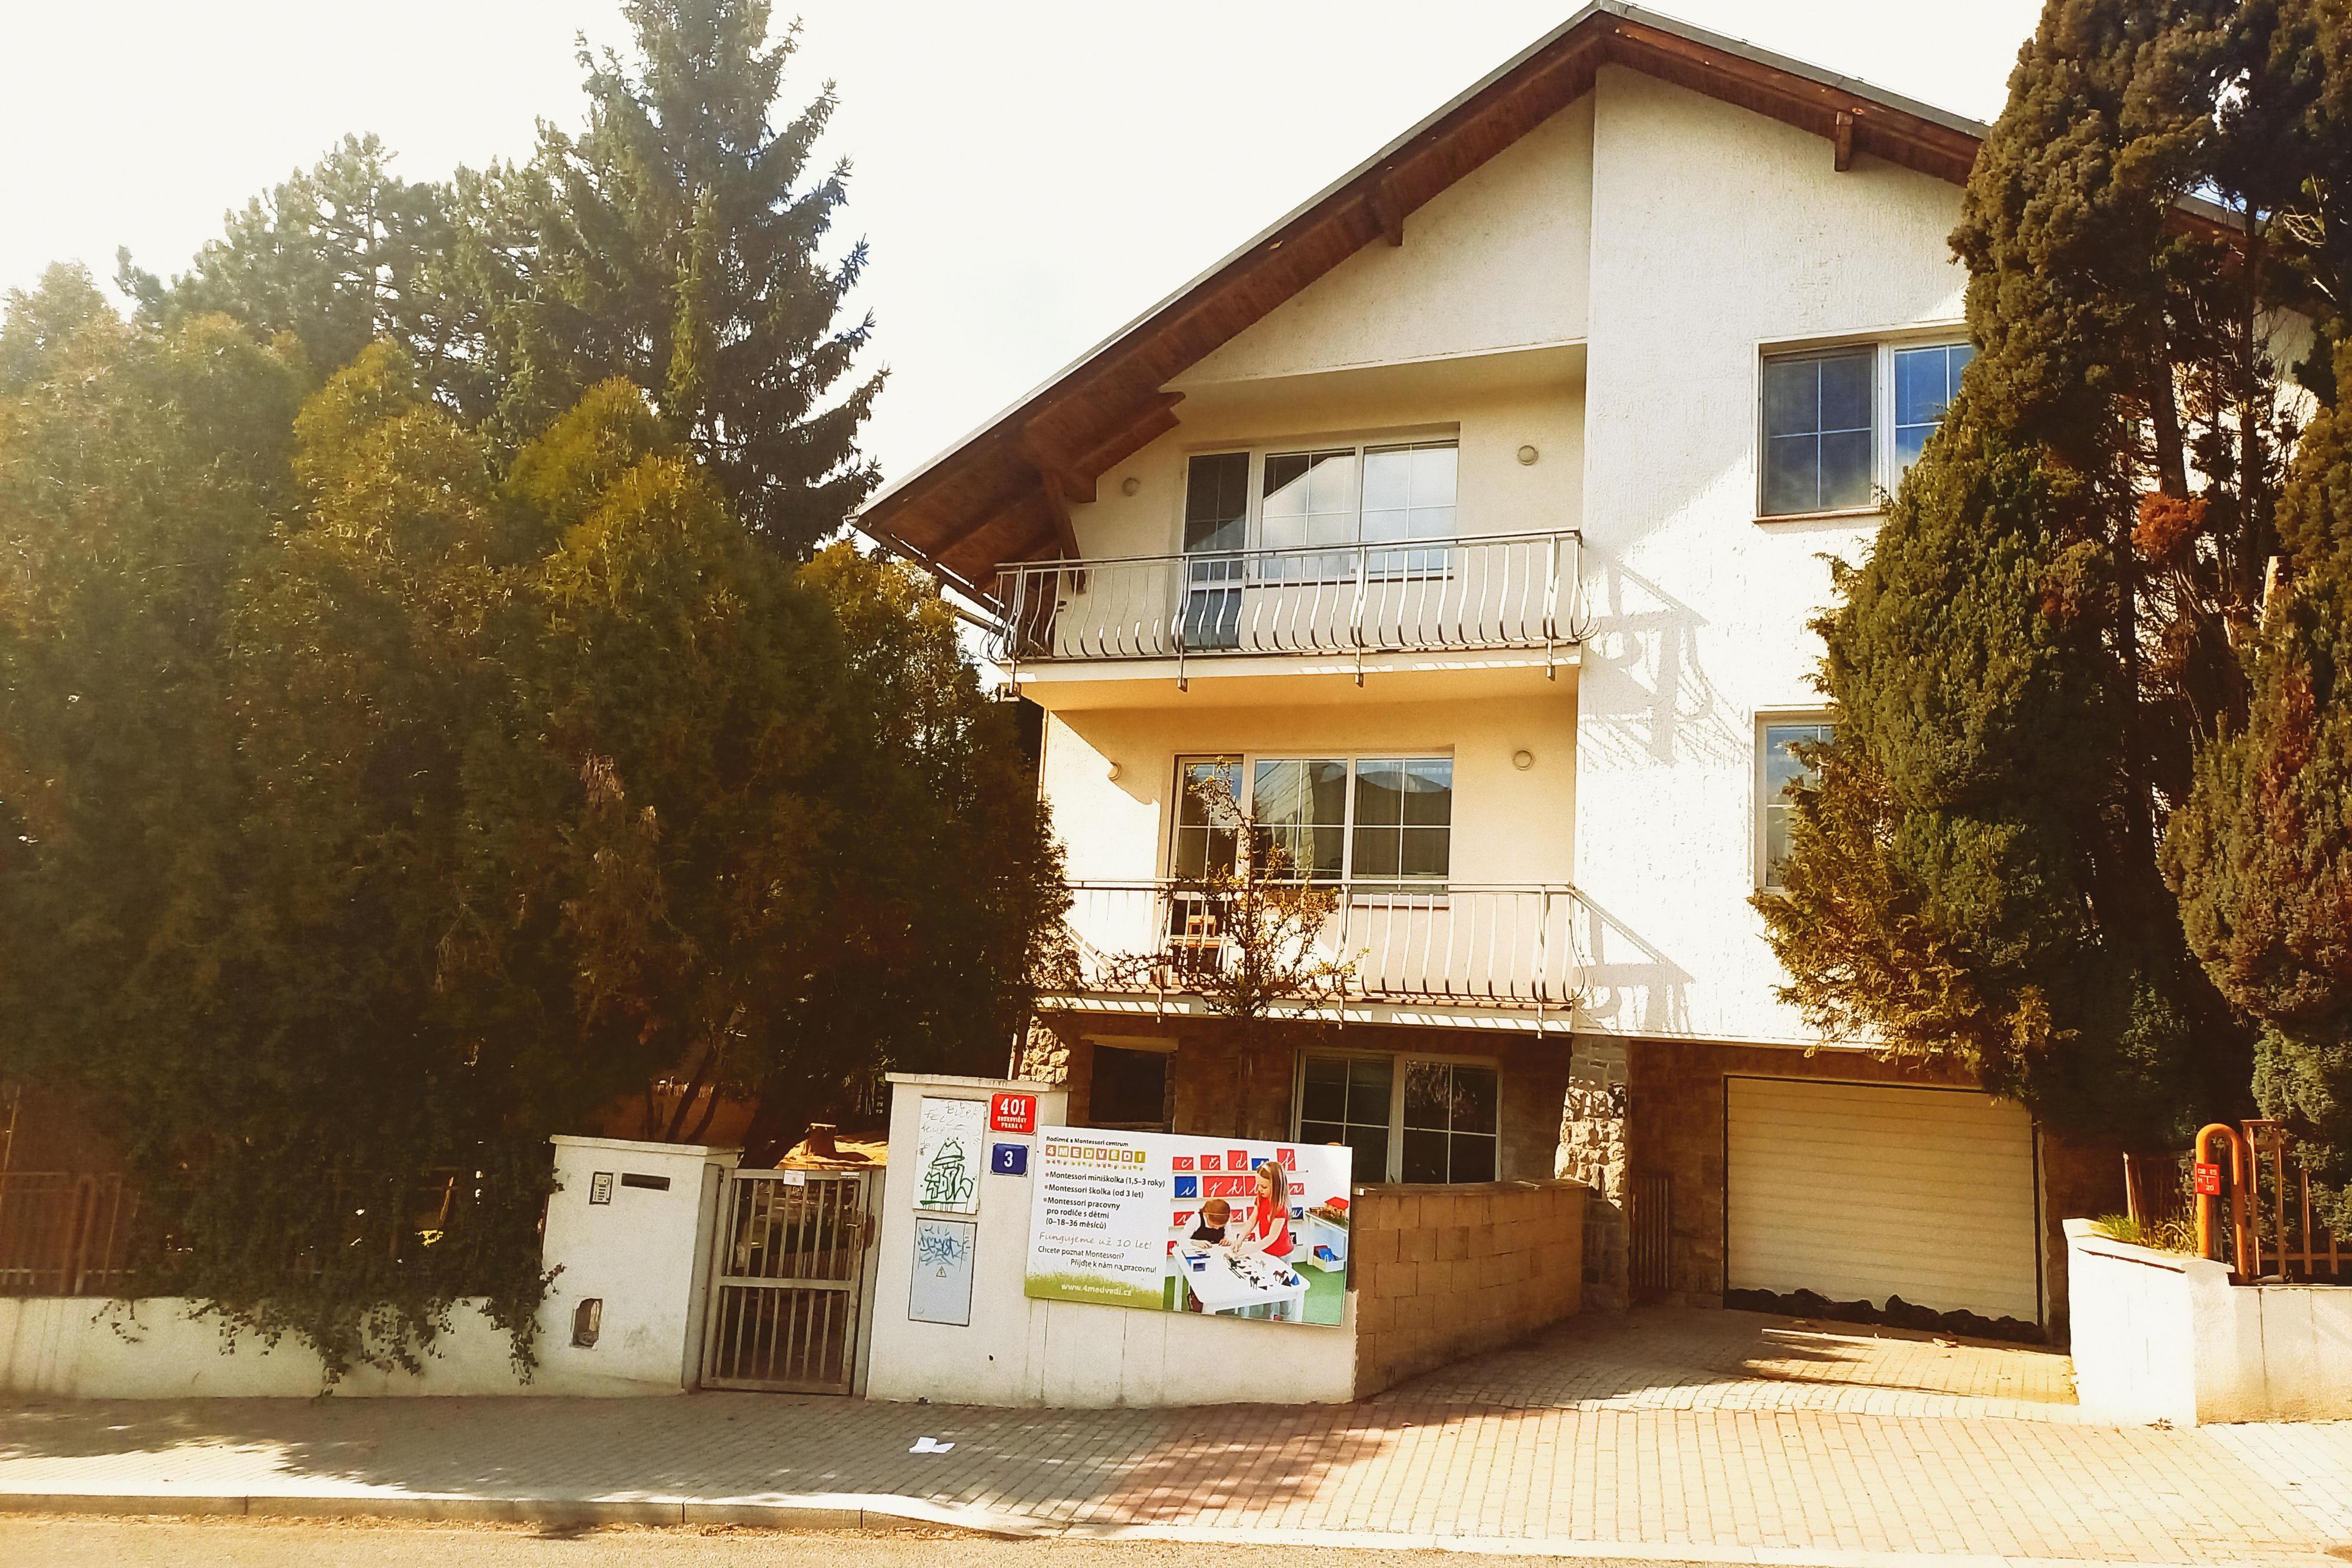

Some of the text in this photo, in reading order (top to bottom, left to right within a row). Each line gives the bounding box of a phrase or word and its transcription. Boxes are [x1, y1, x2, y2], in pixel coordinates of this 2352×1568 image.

[1000, 1098, 1026, 1115] 401
[1004, 1151, 1013, 1168] 3
[1050, 1171, 1087, 1180] Montessori
[1088, 1175, 1124, 1183] miniškolka
[1147, 1179, 1165, 1188] roky)
[1048, 1184, 1087, 1193] Montessori
[1132, 1190, 1144, 1199] let)
[1047, 1197, 1121, 1211] Montessori pracovny
[1060, 1209, 1082, 1217] rodiče
[1088, 1211, 1110, 1219] dětmi
[1079, 1221, 1107, 1229] měsíců)
[1039, 1231, 1152, 1249] Fungujeme už 10 let!
[1085, 1250, 1124, 1259] Montessori?
[1071, 1258, 1091, 1268] Přijďte
[1124, 1265, 1157, 1273] pracovnu!
[1061, 1284, 1132, 1296] www.4medvedi.cz
